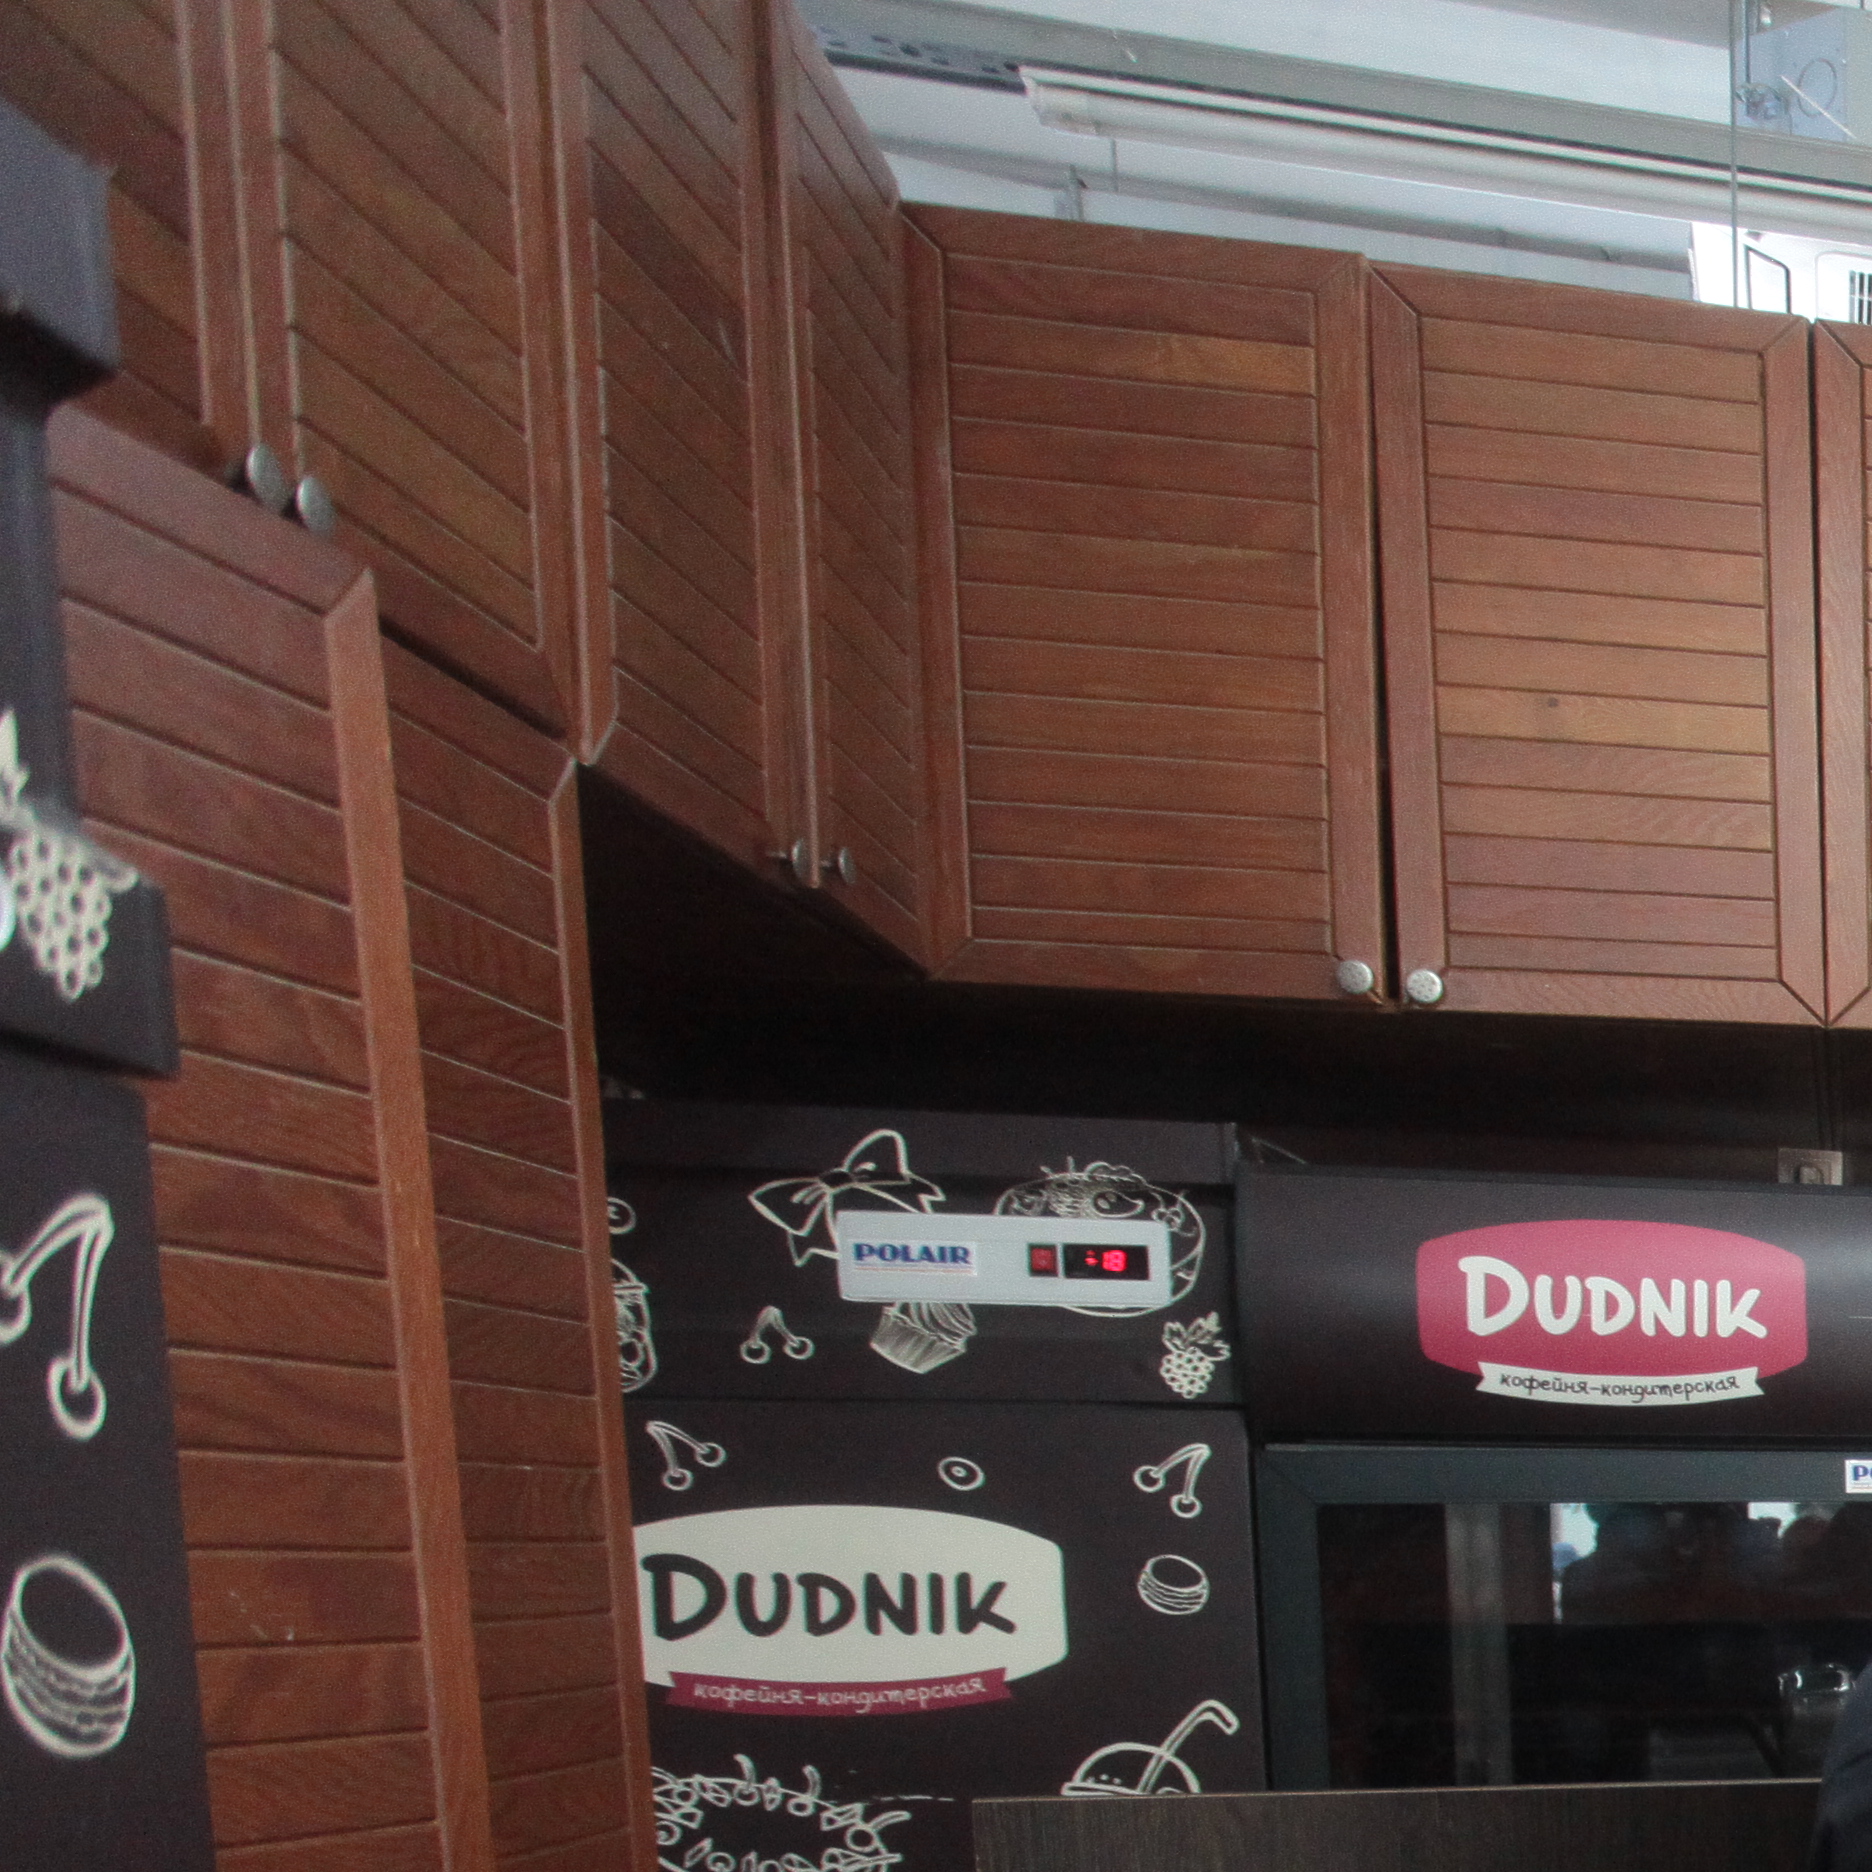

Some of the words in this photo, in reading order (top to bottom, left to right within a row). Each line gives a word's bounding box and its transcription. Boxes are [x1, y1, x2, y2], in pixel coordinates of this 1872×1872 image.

[853, 1242, 972, 1265] POLAIR
[1458, 1254, 1768, 1339] DUDNIK
[1500, 1371, 1741, 1404] кофейня-кондитерская
[641, 1552, 1018, 1642] DUDNIK
[693, 1676, 987, 1715] кофейня-кондитерская
